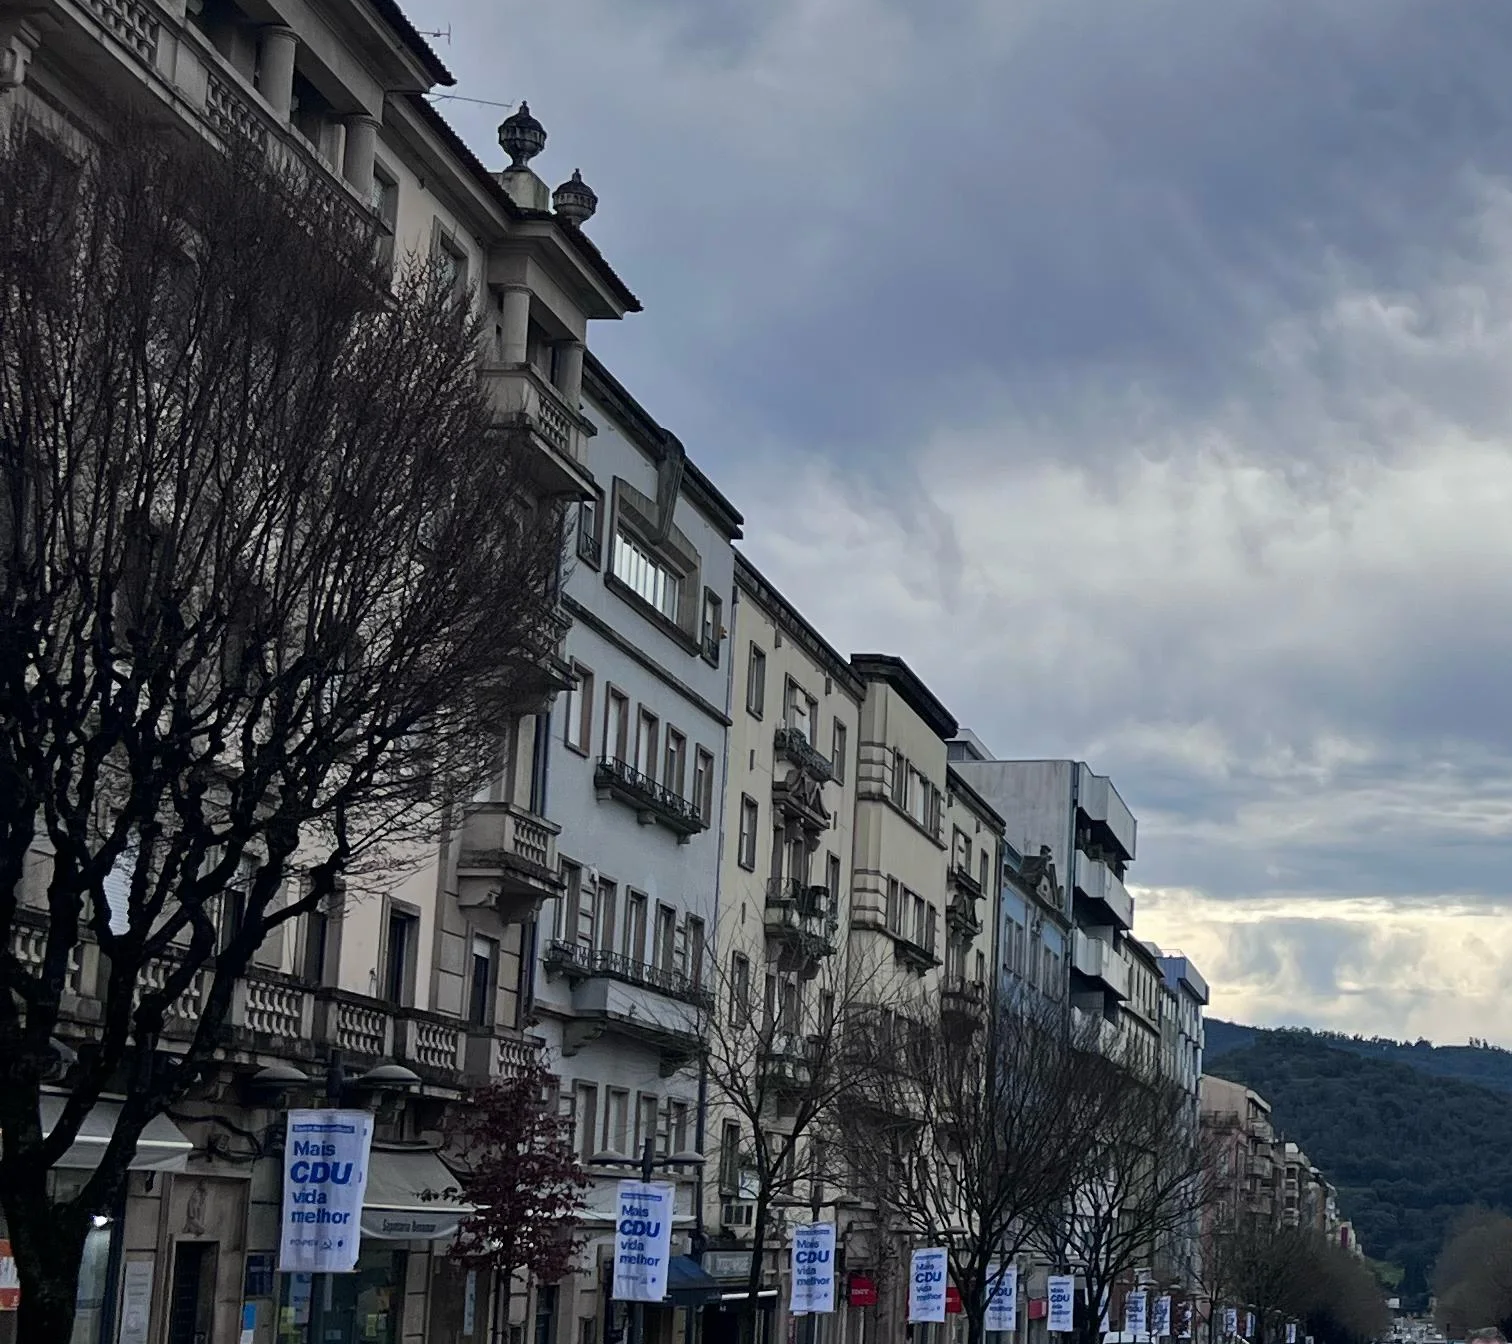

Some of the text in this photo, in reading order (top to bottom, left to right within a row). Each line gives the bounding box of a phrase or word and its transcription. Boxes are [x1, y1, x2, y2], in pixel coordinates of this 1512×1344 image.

[294, 1141, 336, 1156] Mais
[290, 1161, 354, 1185] CDU
[292, 1189, 327, 1204] vida
[291, 1209, 350, 1224] melhor
[622, 1205, 648, 1217] Mais
[620, 1220, 660, 1238] CDU
[621, 1239, 644, 1251] vida
[797, 1238, 820, 1248] Mais
[620, 1255, 660, 1266] melhor
[796, 1250, 830, 1263] CDU
[797, 1266, 817, 1275] vida
[797, 1276, 830, 1286] melhor
[915, 1271, 942, 1283] CDU
[1050, 1295, 1070, 1303] CDU
